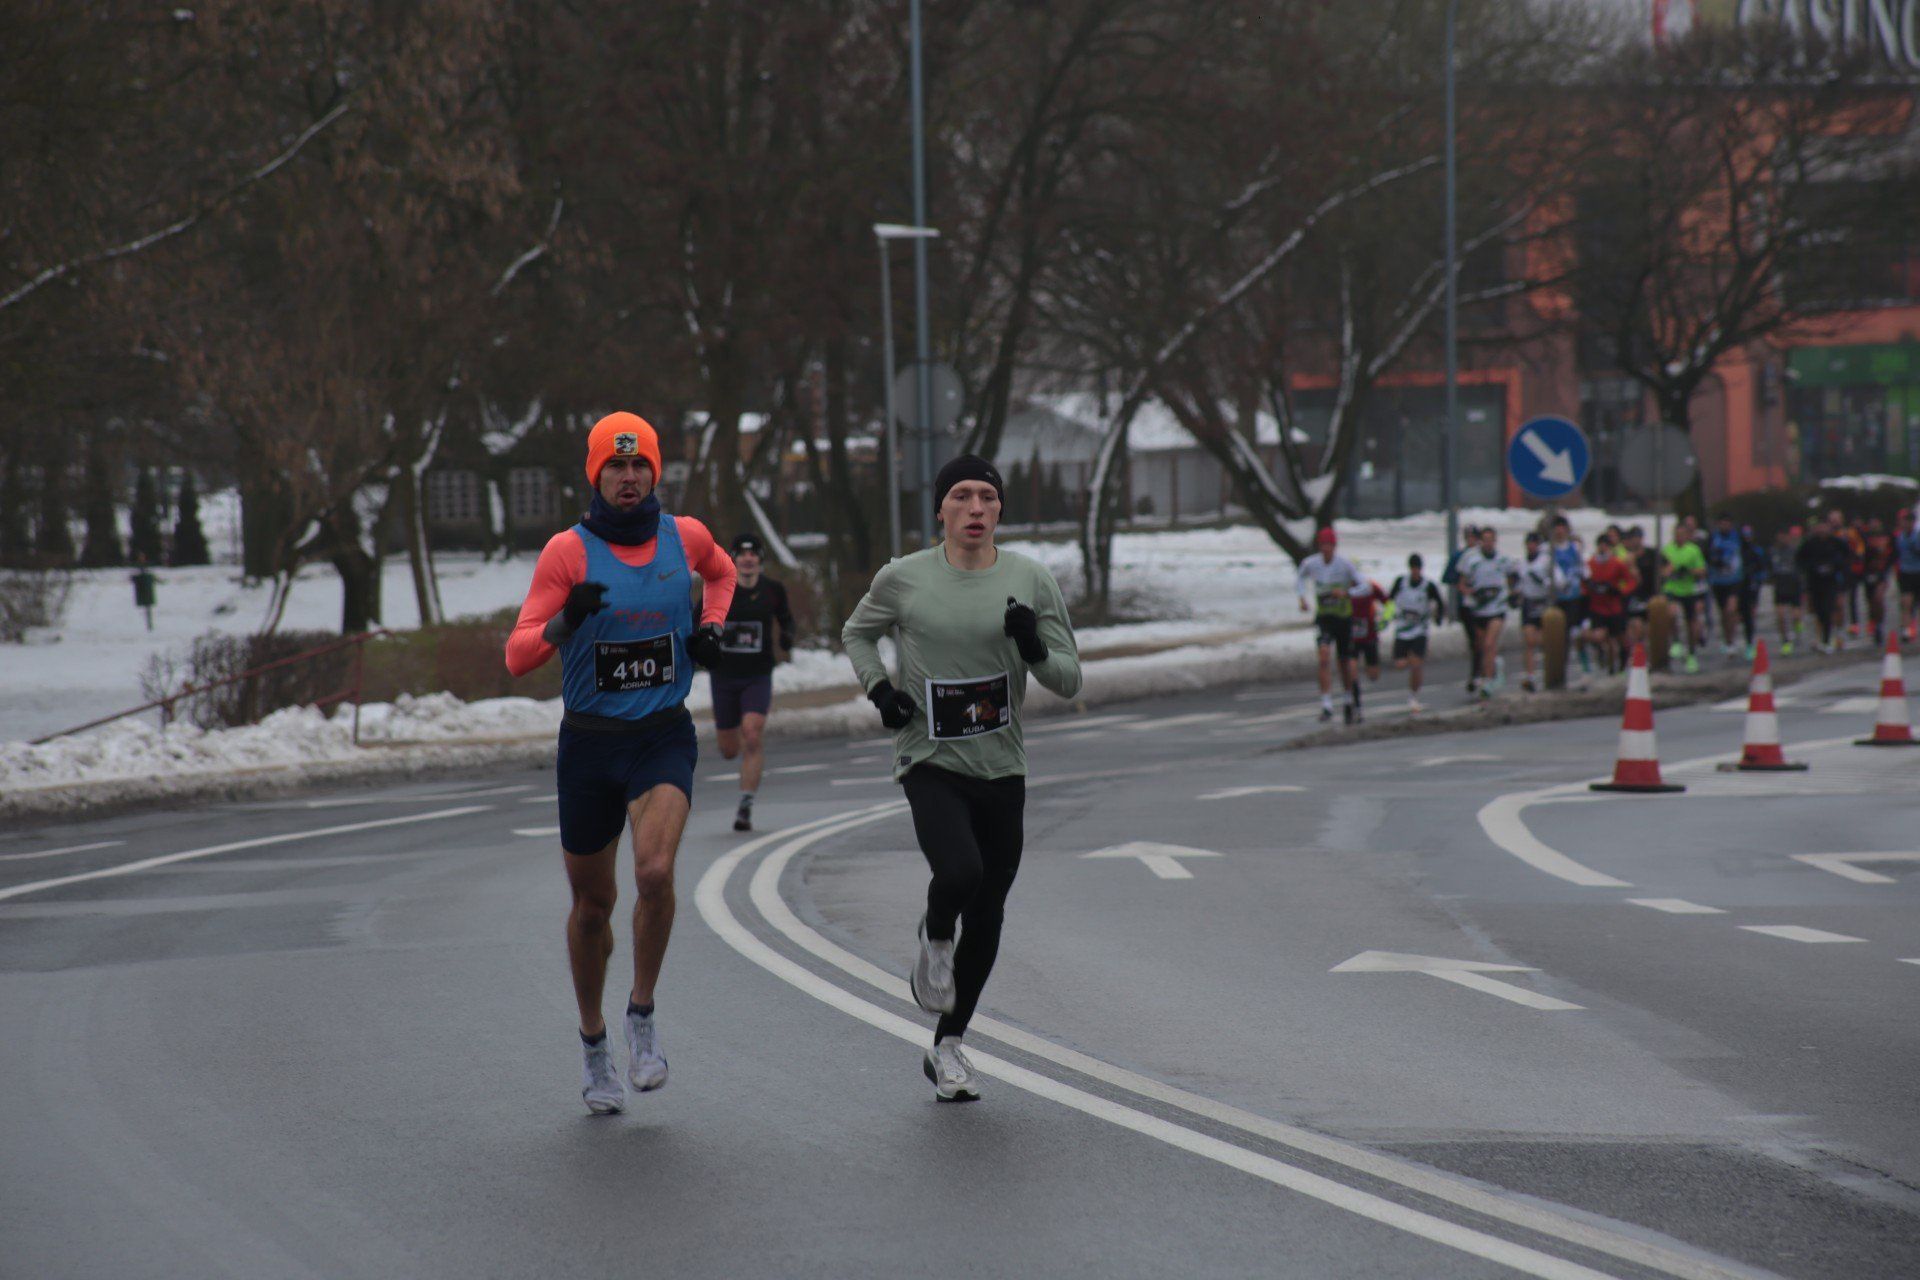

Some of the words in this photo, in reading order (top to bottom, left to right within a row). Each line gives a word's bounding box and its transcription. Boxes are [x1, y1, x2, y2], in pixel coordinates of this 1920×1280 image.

[613, 658, 656, 680] 410
[620, 680, 651, 690] ADRIAN
[966, 702, 977, 723] 1
[962, 724, 985, 735] KUBA
